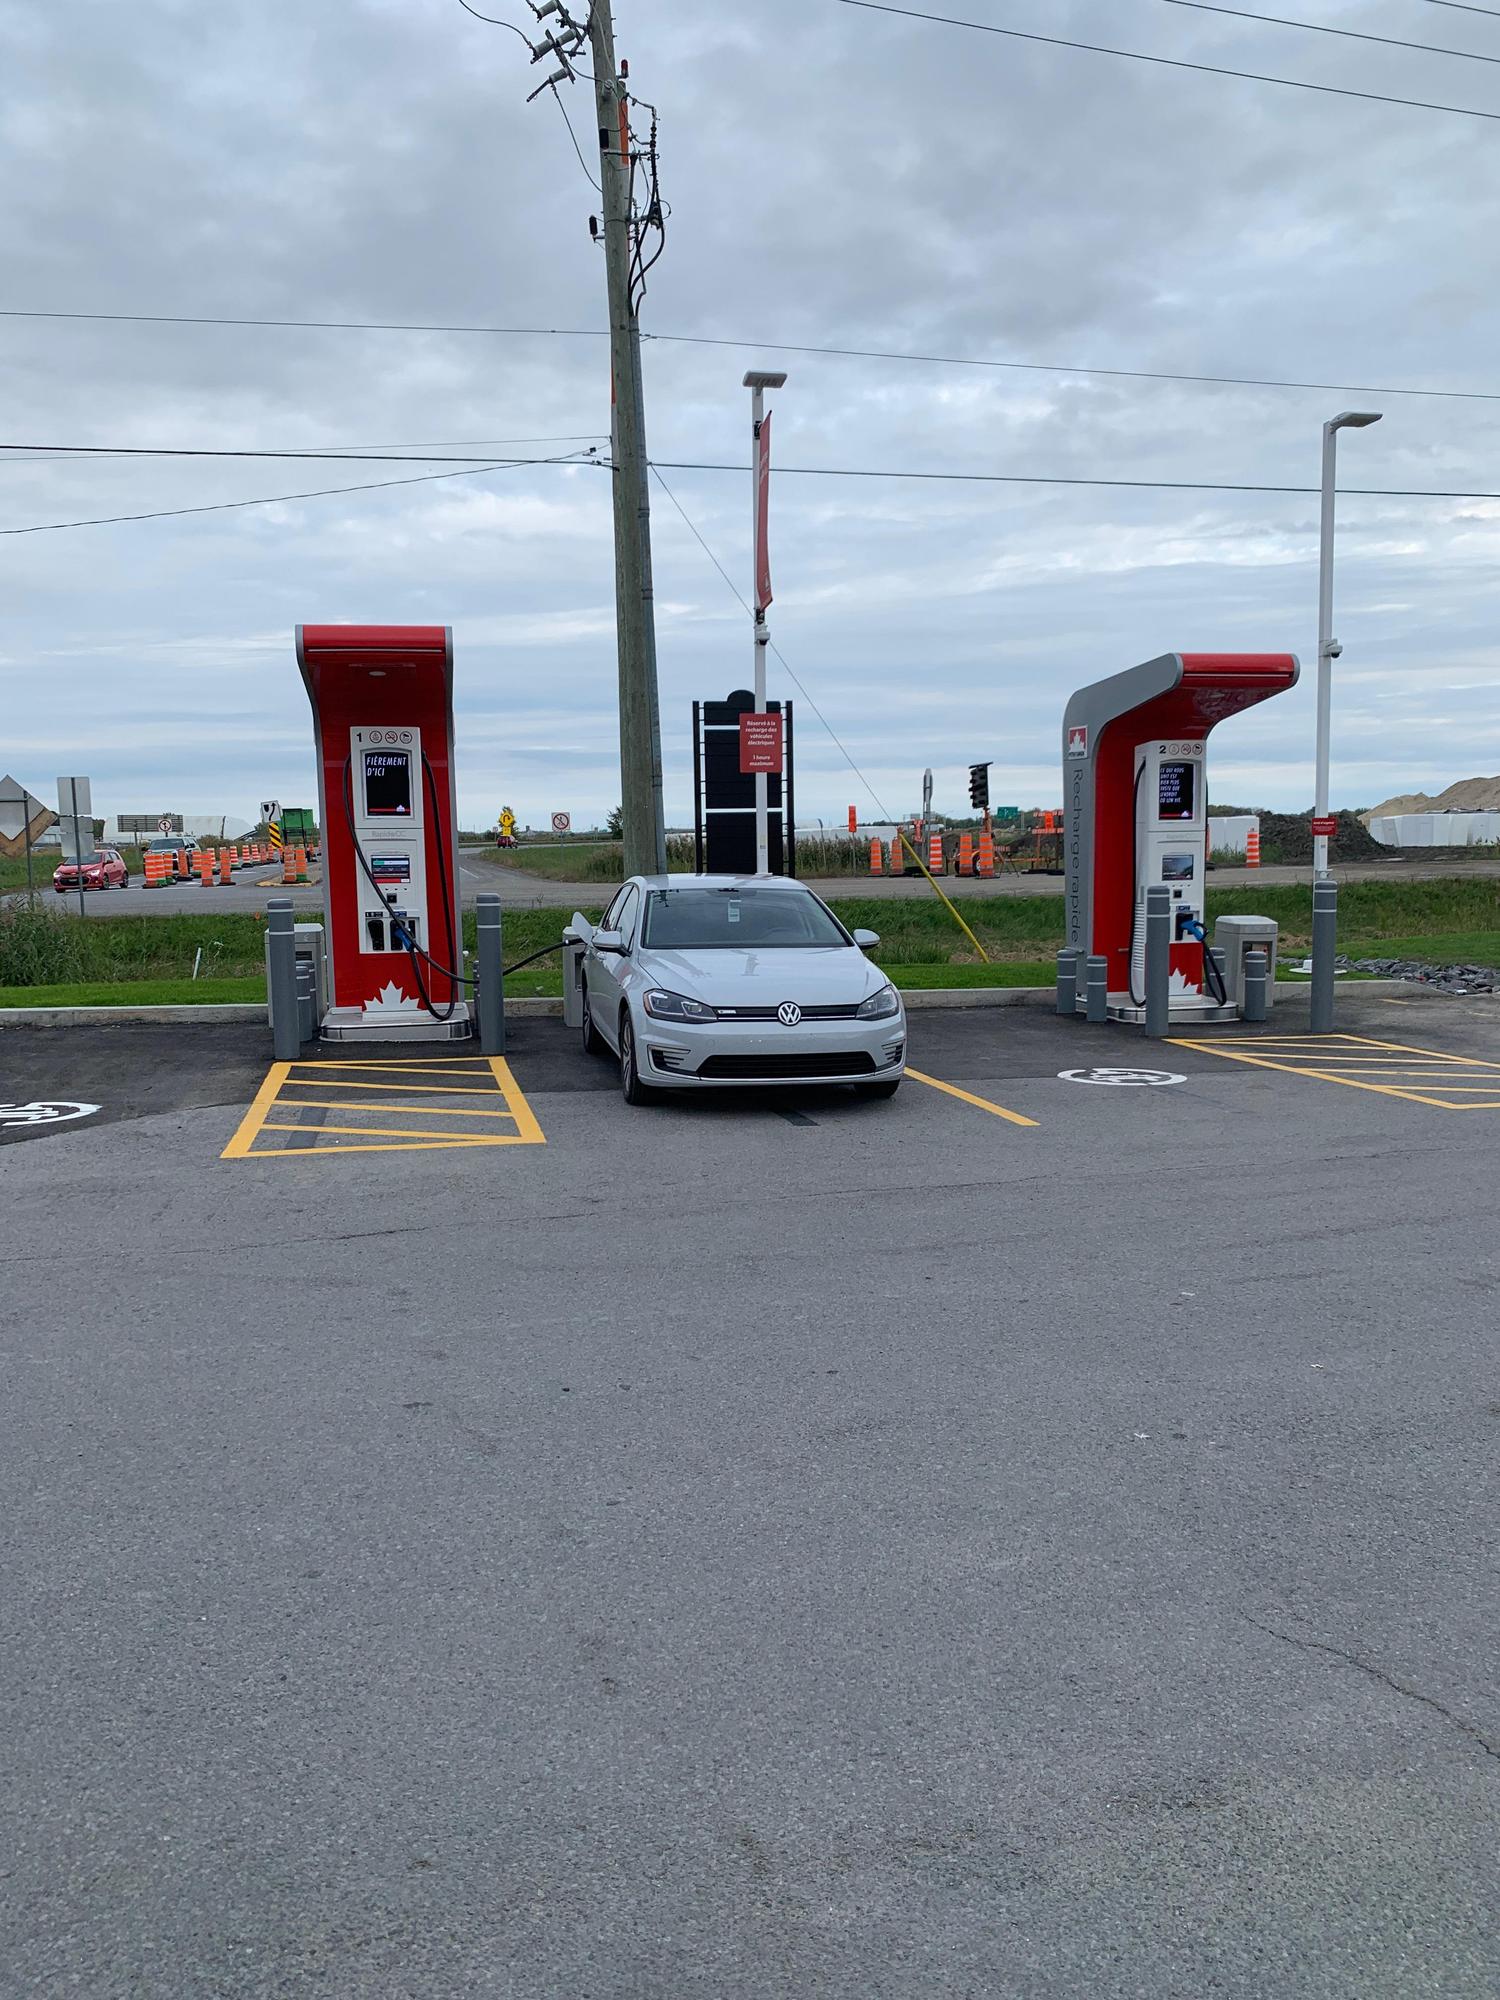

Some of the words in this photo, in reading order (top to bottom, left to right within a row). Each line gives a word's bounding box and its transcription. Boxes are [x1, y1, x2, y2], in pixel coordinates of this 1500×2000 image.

[356, 732, 362, 743] 1
[1159, 744, 1167, 754] 2
[366, 755, 407, 766] FIÈREMENT
[367, 767, 385, 777] D'ICI
[1070, 769, 1083, 869] Recharge
[1071, 874, 1080, 943] rapide
